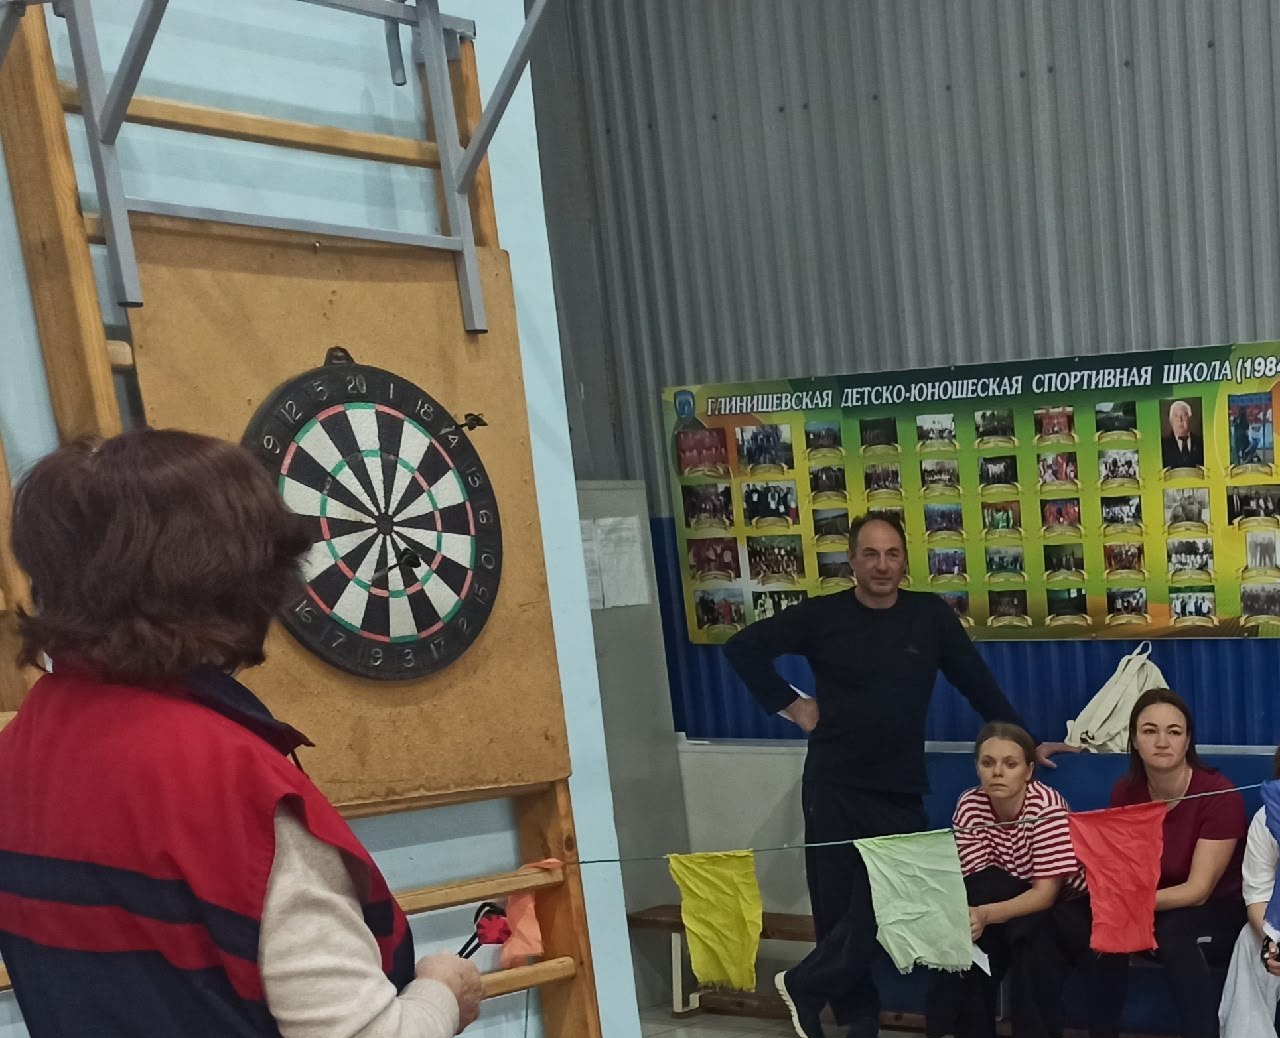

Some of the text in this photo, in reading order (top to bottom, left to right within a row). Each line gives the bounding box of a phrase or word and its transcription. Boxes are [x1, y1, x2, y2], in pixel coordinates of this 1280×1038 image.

[312, 376, 328, 400] 5
[346, 375, 367, 394] 20
[389, 382, 394, 399] 1
[707, 389, 833, 416] ГЛИНИЩЕВСКАЯ
[841, 375, 1023, 408] ДЕТСКО-ЮНОШЕСКАЯ
[1032, 366, 1152, 394] СПОРТИВНАЯ
[1162, 360, 1232, 385] ШКОЛА
[280, 400, 302, 424] 12
[415, 399, 434, 420] 18
[263, 435, 280, 454] 9
[478, 509, 494, 524] 6
[294, 599, 321, 624] 16
[331, 631, 347, 648] 7
[402, 649, 416, 668] 3
